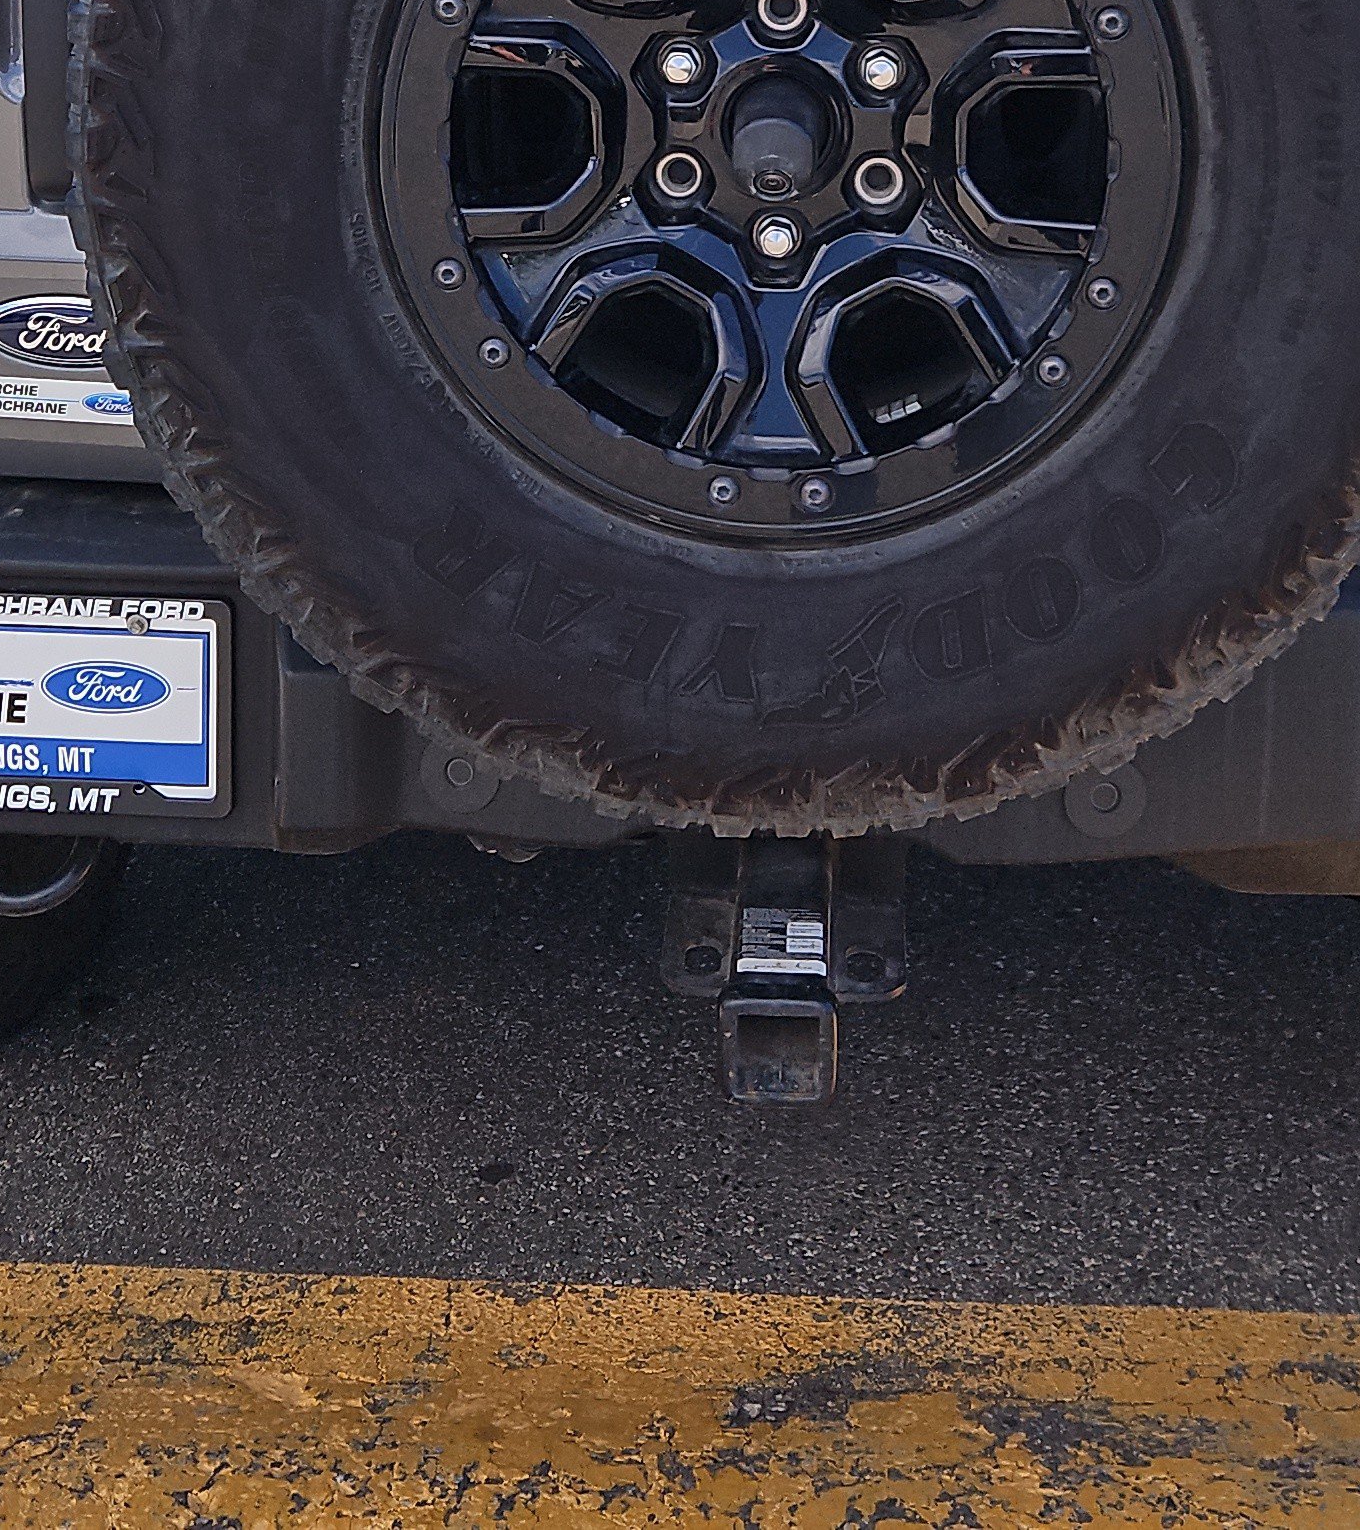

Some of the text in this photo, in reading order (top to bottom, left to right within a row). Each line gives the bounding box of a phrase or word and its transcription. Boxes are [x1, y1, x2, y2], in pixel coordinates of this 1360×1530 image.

[18, 312, 108, 353] Ford
[119, 600, 205, 622] FORD
[67, 668, 145, 706] Ford
[57, 747, 96, 774] MT
[68, 788, 120, 813] MT
